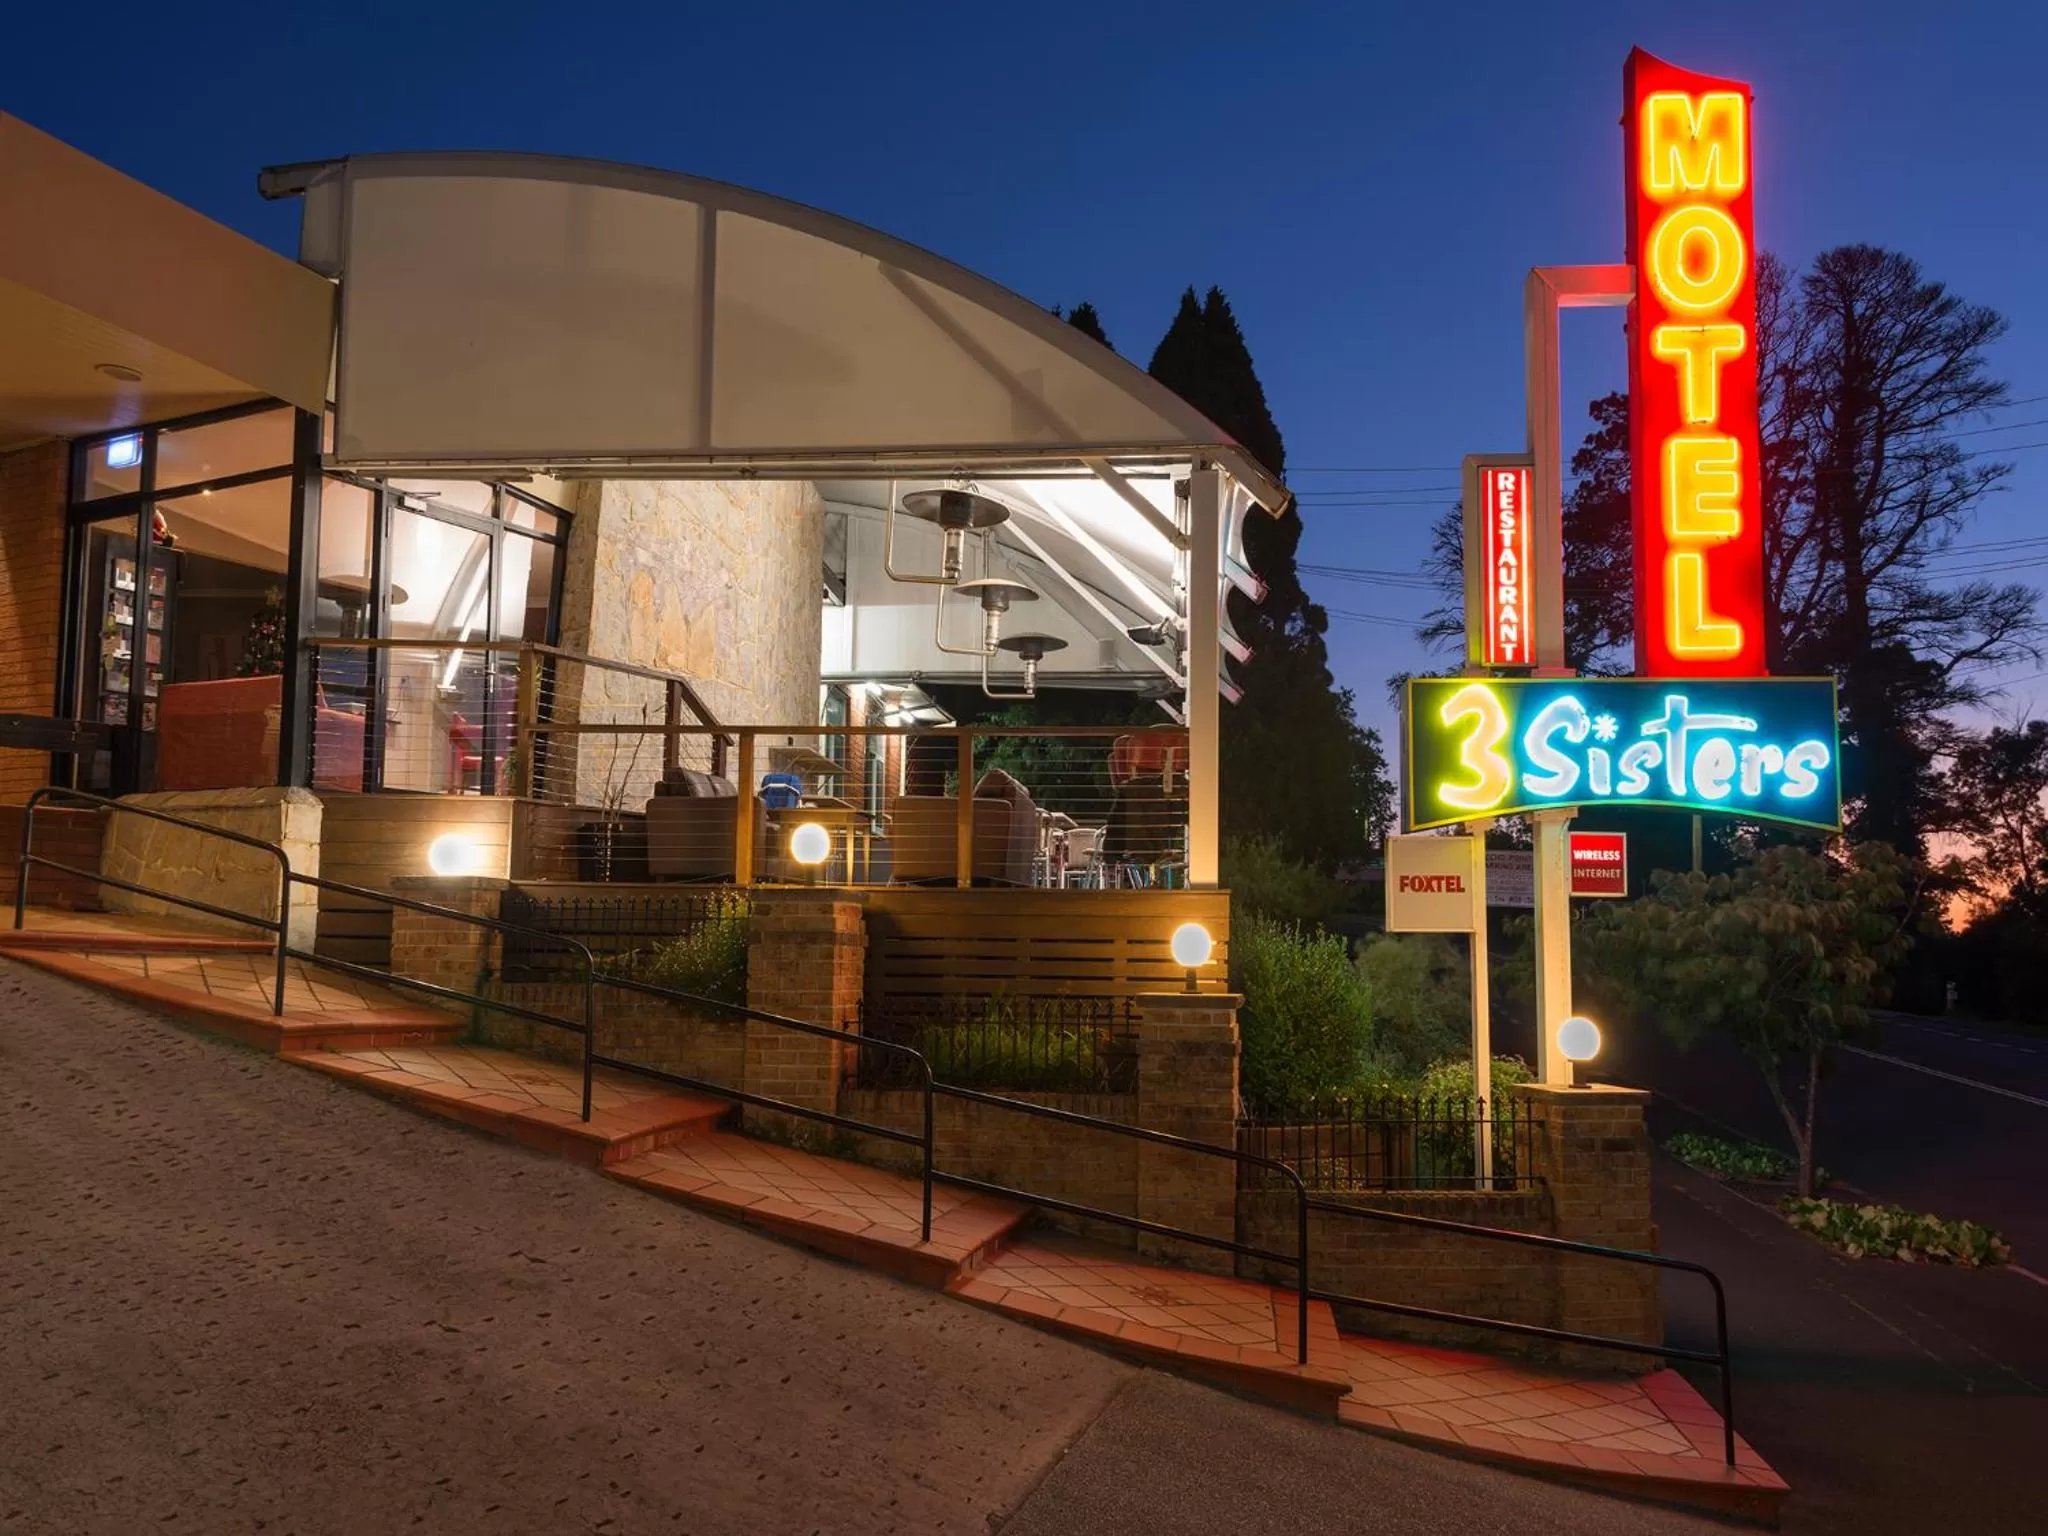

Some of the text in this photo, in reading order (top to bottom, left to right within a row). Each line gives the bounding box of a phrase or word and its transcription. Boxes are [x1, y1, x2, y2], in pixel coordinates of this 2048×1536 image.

[1646, 91, 1746, 655] MOTEL
[1497, 472, 1518, 662] RESTAURANT
[1438, 684, 1830, 809] 3 Sisters
[1399, 875, 1466, 893] FOXTEL
[1572, 849, 1621, 861] WIRELESS
[1573, 868, 1621, 878] INTERNET
